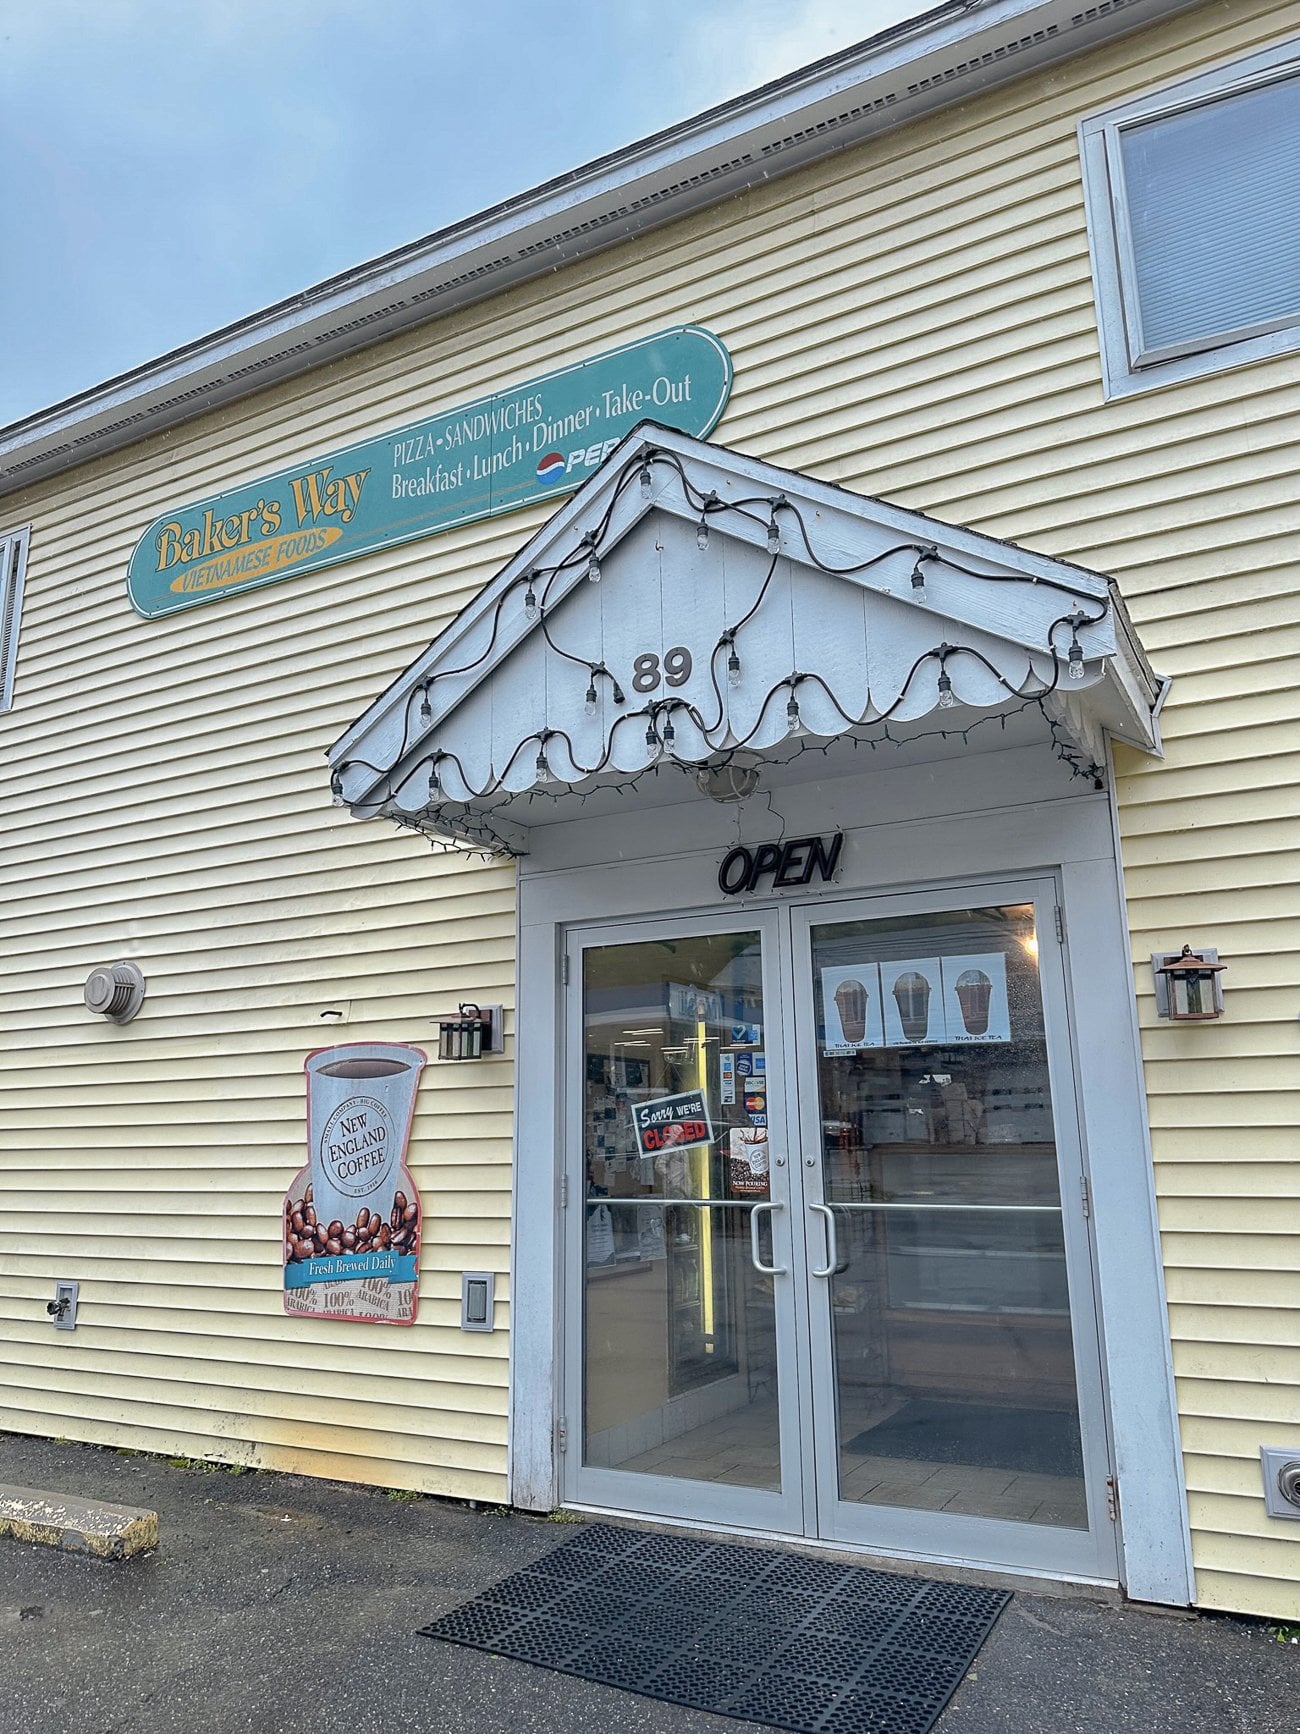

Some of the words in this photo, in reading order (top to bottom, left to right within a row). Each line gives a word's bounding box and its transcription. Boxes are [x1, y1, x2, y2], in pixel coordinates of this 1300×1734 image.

[392, 461, 463, 499] Breakfast
[472, 439, 522, 481] Lunch
[532, 404, 593, 452] Dinner
[602, 373, 692, 419] Take-Out
[394, 433, 434, 467] PIZZA
[444, 394, 543, 450] SANDWICHES
[566, 437, 621, 473] PEP
[155, 498, 282, 572] Baker's
[289, 466, 372, 528] Way
[182, 548, 271, 591] VIETNAMESE
[277, 529, 330, 562] FOODS
[632, 646, 692, 693] 89
[718, 832, 844, 895] OPEN
[340, 1113, 367, 1137] NEW
[640, 1106, 674, 1128] Sorry
[676, 1102, 702, 1116] WE'RE
[750, 1115, 766, 1124] ISA
[329, 1126, 386, 1162] ENGLAND
[643, 1121, 705, 1149] CLOSED
[337, 1147, 385, 1179] COFFEE
[309, 1260, 333, 1275] Fresh
[336, 1257, 368, 1273] Brewed
[371, 1254, 396, 1270] Daily
[323, 1291, 354, 1308] 100%
